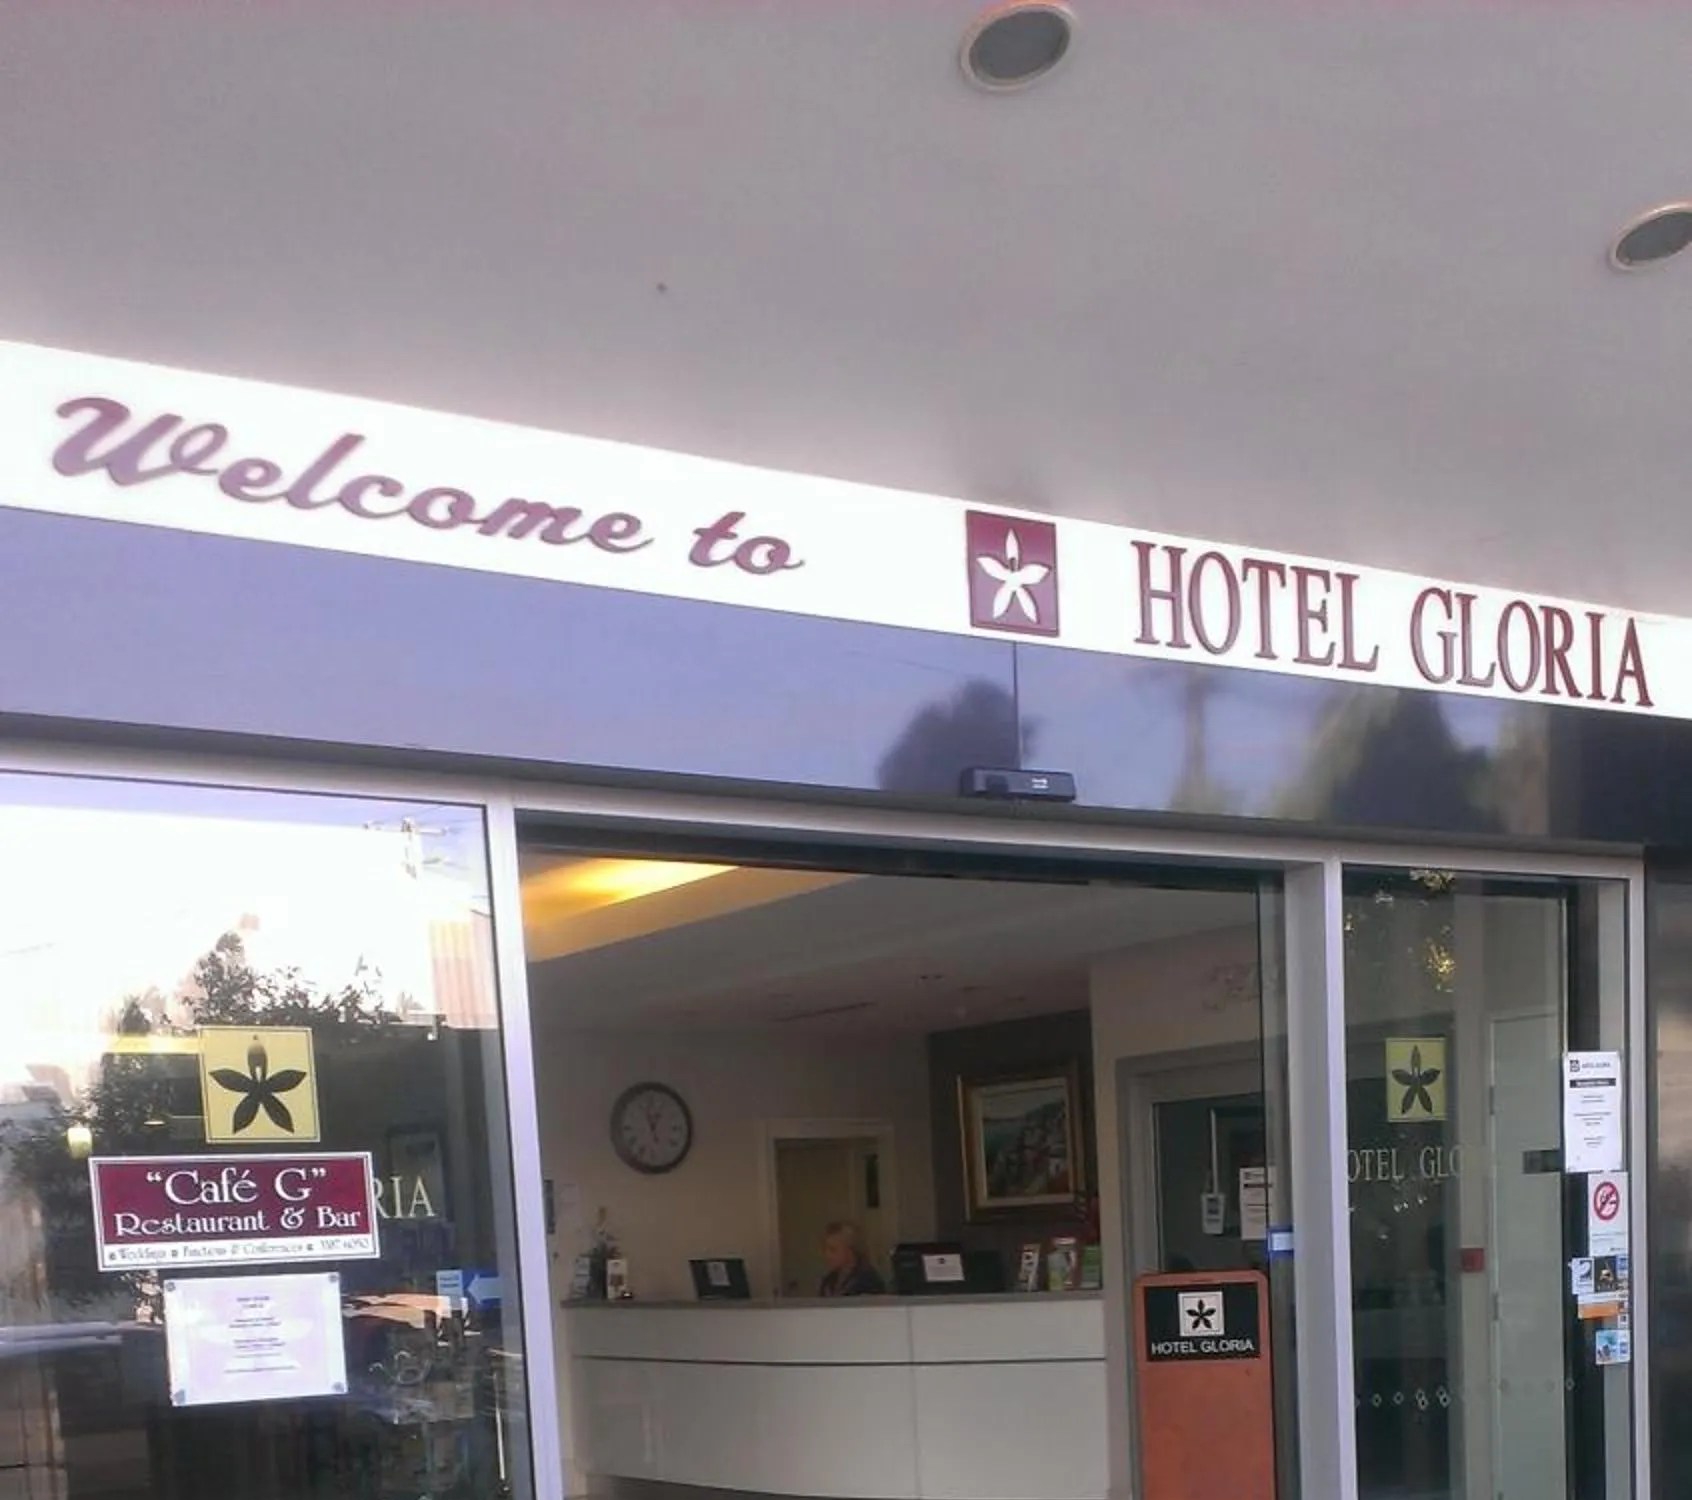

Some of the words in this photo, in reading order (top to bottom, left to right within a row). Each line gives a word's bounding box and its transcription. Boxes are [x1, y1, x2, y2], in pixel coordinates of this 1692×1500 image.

[52, 396, 655, 553] Welcome
[688, 511, 806, 574] to
[1130, 540, 1379, 672] HOTEL
[1409, 586, 1655, 707] GLORIA
[1347, 1147, 1405, 1183] OTEL
[373, 1175, 437, 1219] RIA
[113, 1210, 270, 1237] Restaurant
[280, 1207, 305, 1229] &
[317, 1205, 360, 1229] Bar
[1151, 1340, 1198, 1355] HOTEL
[1200, 1338, 1255, 1353] GLORIA
